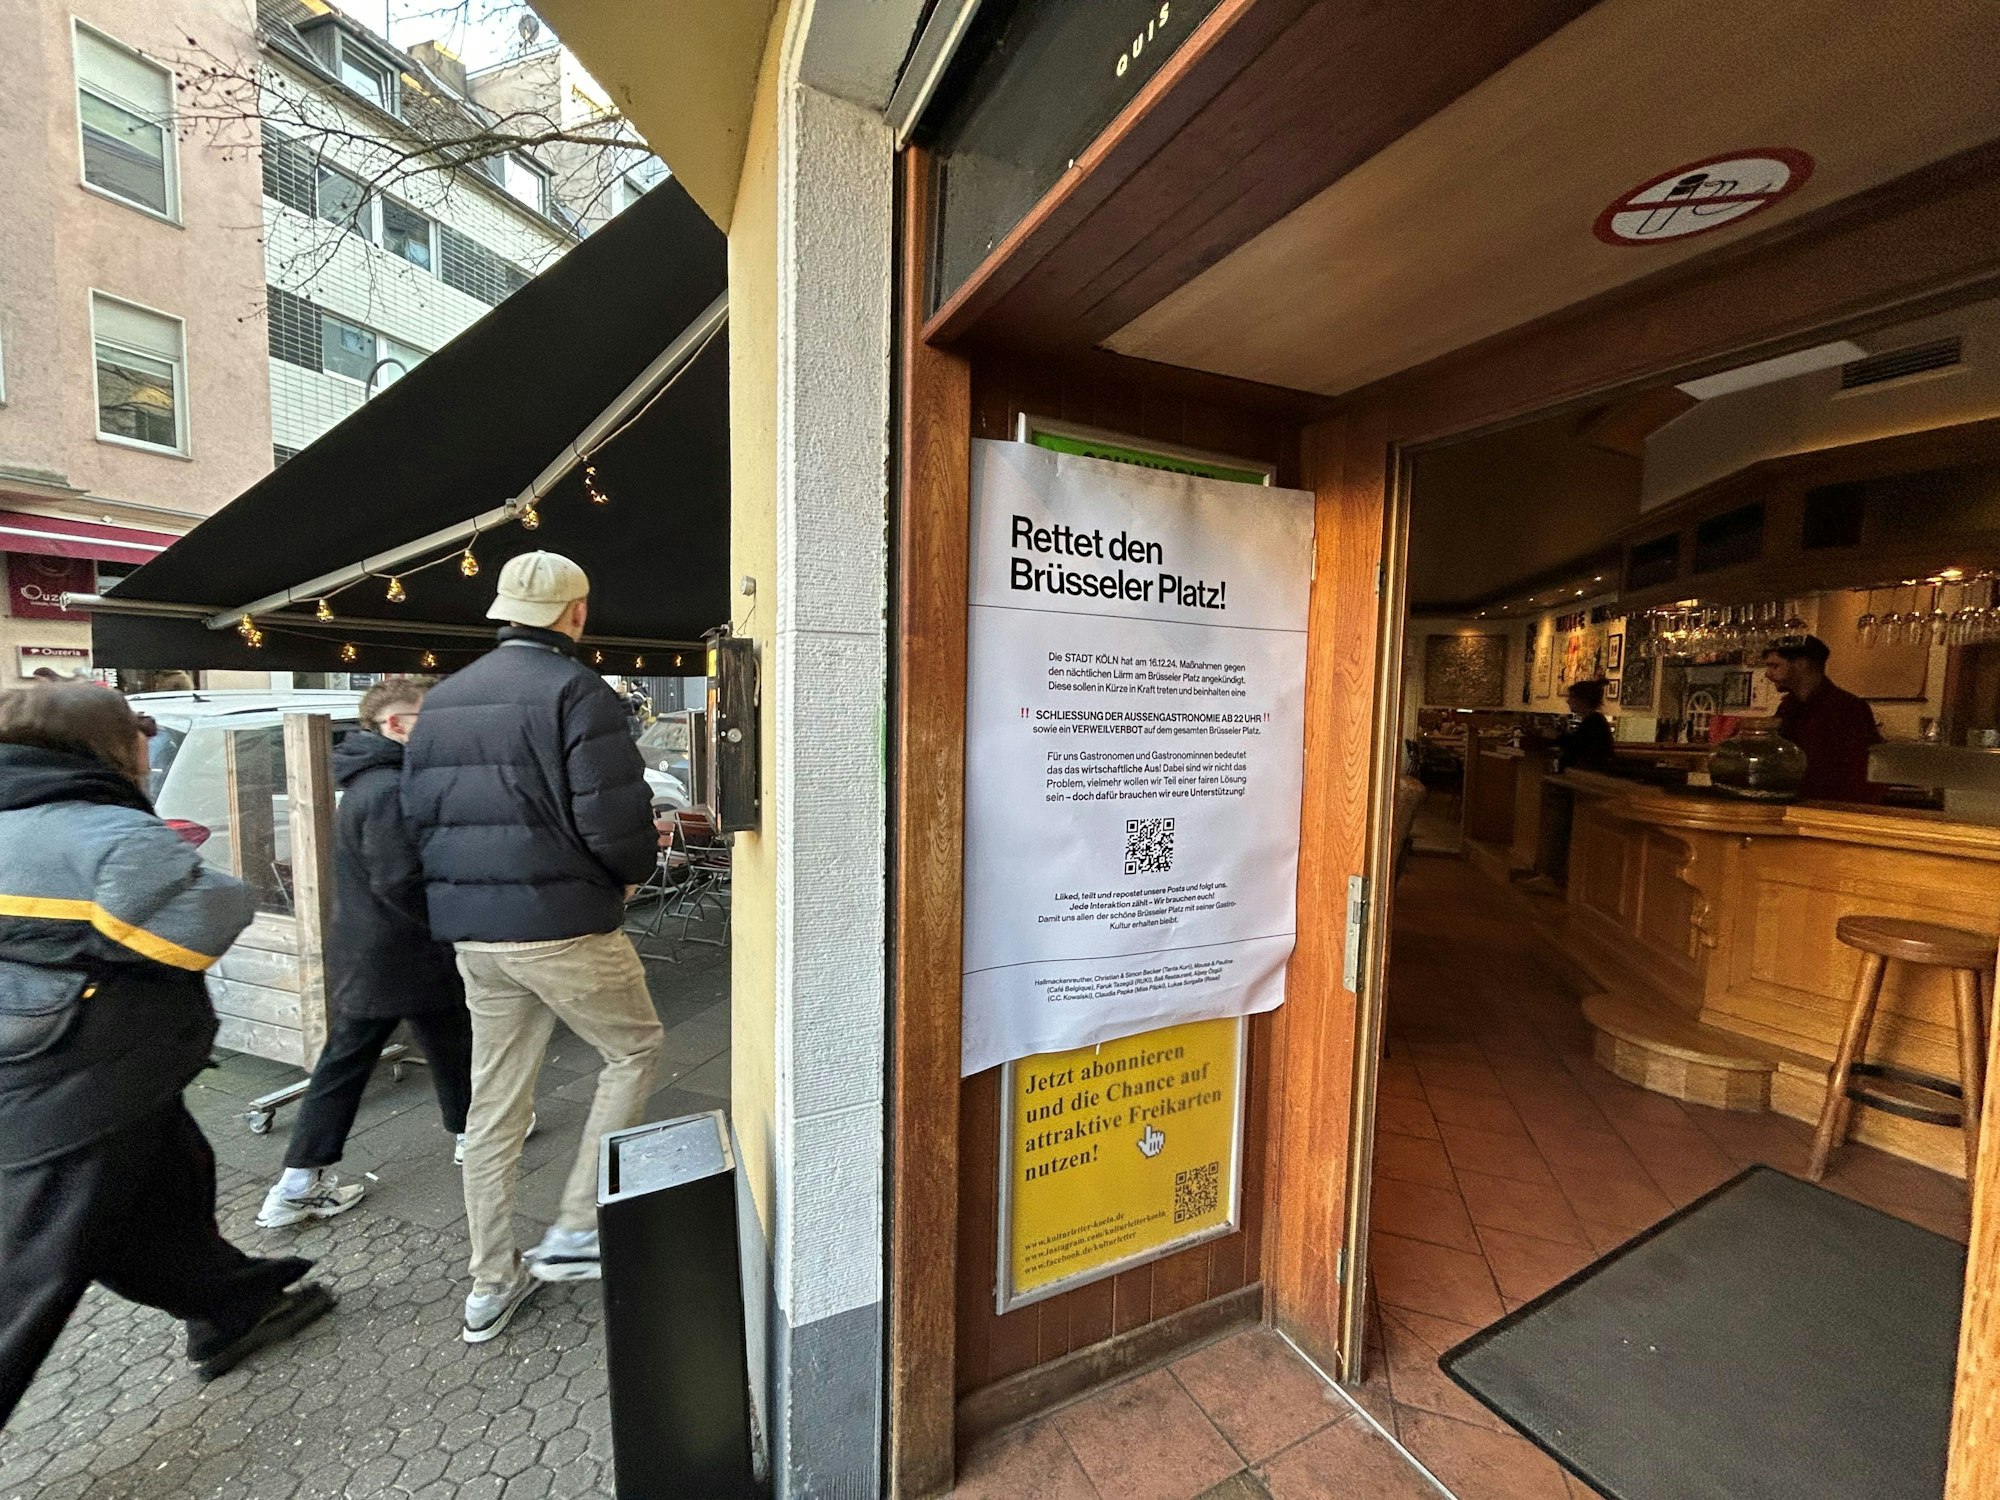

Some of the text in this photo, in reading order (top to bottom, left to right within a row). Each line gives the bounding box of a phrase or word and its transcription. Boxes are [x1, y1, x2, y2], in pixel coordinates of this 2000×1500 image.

[1012, 515, 1163, 565] Rettet den
[1011, 557, 1226, 610] Brüsseler Platz!
[41, 648, 81, 656] Ouzeria
[1048, 652, 1062, 662] Die
[1065, 653, 1093, 663] STADT
[1095, 653, 1119, 664] KÖLN
[1121, 657, 1133, 666] hat
[1149, 658, 1178, 668] 16.12.24.
[1180, 660, 1222, 670] Maßnahmen
[1224, 664, 1246, 672] gegen
[1048, 667, 1064, 676] den
[1066, 668, 1111, 678] nächtlichen
[1113, 670, 1133, 679] Lärm
[1148, 672, 1181, 682] Brüsseler
[1183, 673, 1200, 682] Platz
[1201, 676, 1246, 686] angekündigt.
[1048, 681, 1246, 697] Diese sollen in Kürze in Kraft treten und beinhalten eine
[1036, 710, 1104, 720] SCHLIESSUNG
[1104, 712, 1123, 721] DER
[1124, 712, 1220, 722] AUSSENGASTRONOMIE
[1222, 714, 1233, 722] AB
[1244, 714, 1262, 723] UHR
[1032, 724, 1261, 736] sowie ein VERWEILVERBOT auf dem gesamten Brüsseler Platz.
[1047, 750, 1246, 760] Für uns Gastronomen und Gastronominnen bedeutet
[1046, 763, 1246, 774] das das wirtschaftliche Aus! Dabei sind wir nicht das
[1046, 775, 1246, 789] Problem, vielmehr wollen wir Teil einer fairen Lösung
[1046, 792, 1064, 802] sein
[1072, 792, 1094, 801] doch
[1096, 790, 1118, 800] dafür
[1119, 790, 1158, 800] brauchen
[1158, 788, 1170, 798] wir
[1172, 790, 1189, 798] eure
[1190, 787, 1246, 798] Unterstützung!
[1097, 891, 1112, 900] und
[1112, 889, 1143, 899] repostet
[1167, 886, 1185, 894] Posts
[1186, 884, 1198, 892] und
[1199, 882, 1214, 891] folgt
[1070, 902, 1088, 911] Jede
[1090, 901, 1130, 910] Interaktion
[1132, 900, 1148, 908] zählt
[1153, 897, 1165, 905] Wir
[1166, 894, 1196, 904] brauchen
[1197, 892, 1215, 900] euch!
[1076, 913, 1094, 921] allen
[1110, 910, 1136, 919] schöne
[1137, 908, 1168, 918] Brüsseler
[1216, 900, 1237, 909] Gastro-
[1110, 916, 1178, 930] Kultur erhalten bleibt.
[1094, 974, 1120, 982] Christian
[1046, 986, 1064, 994] (Café
[1025, 1046, 1185, 1095] Jetzt abonnieren
[1026, 1062, 1210, 1124] und die Chance auf
[1025, 1089, 1222, 1153] attraktive Freikarten
[1024, 1144, 1098, 1182] nutzen!
